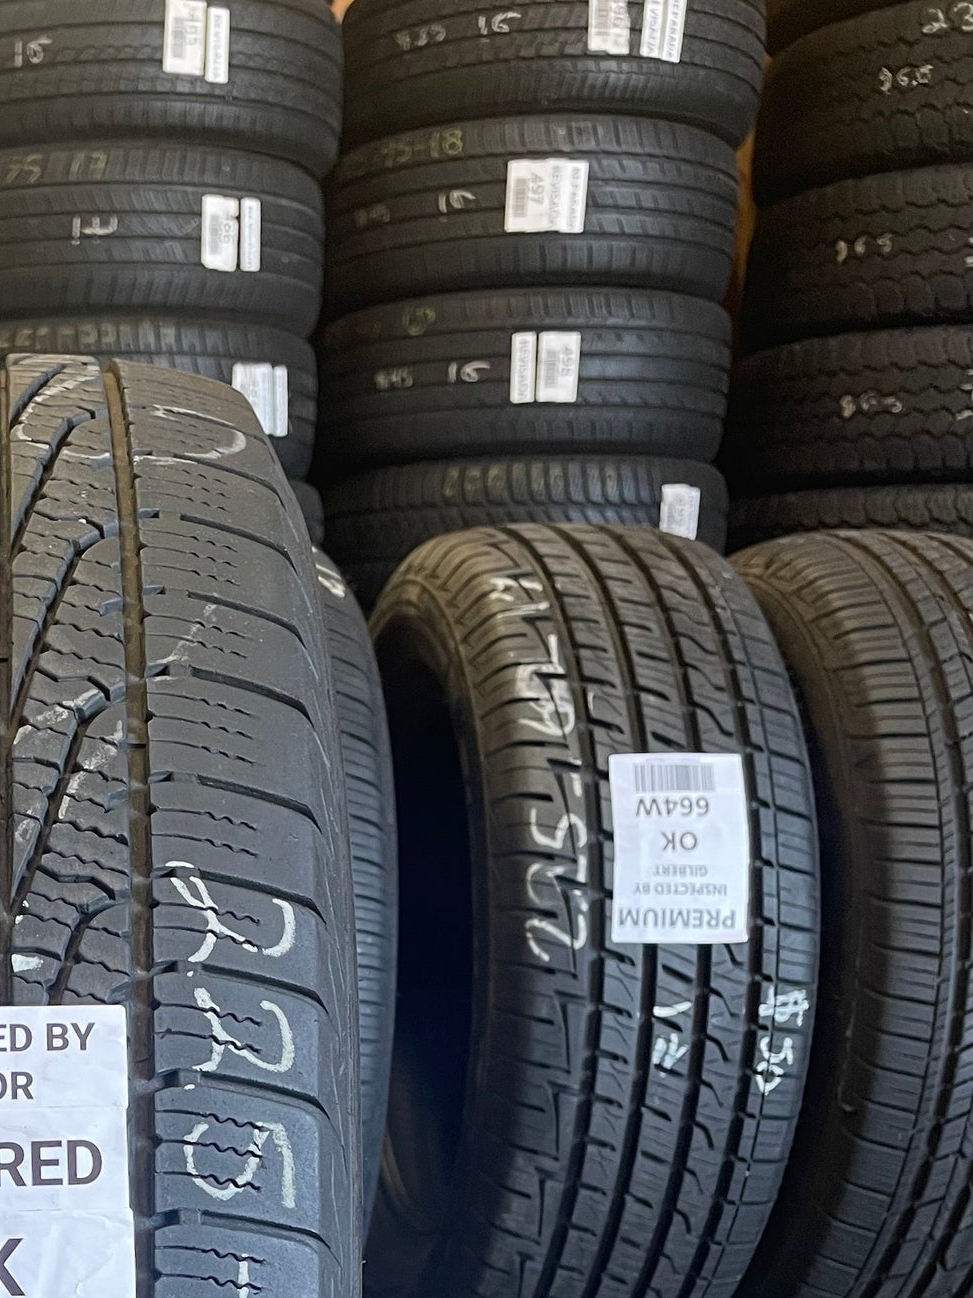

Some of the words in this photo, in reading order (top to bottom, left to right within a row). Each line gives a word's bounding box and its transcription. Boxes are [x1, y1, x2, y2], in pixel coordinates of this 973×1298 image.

[530, 172, 544, 205] 497
[635, 797, 710, 817] 664W
[660, 830, 698, 851] OK
[653, 864, 708, 878] GILBERT
[633, 882, 650, 896] BY
[654, 882, 728, 896] INSPECTED
[619, 907, 736, 930] PREMIUM
[46, 1022, 95, 1052] BY
